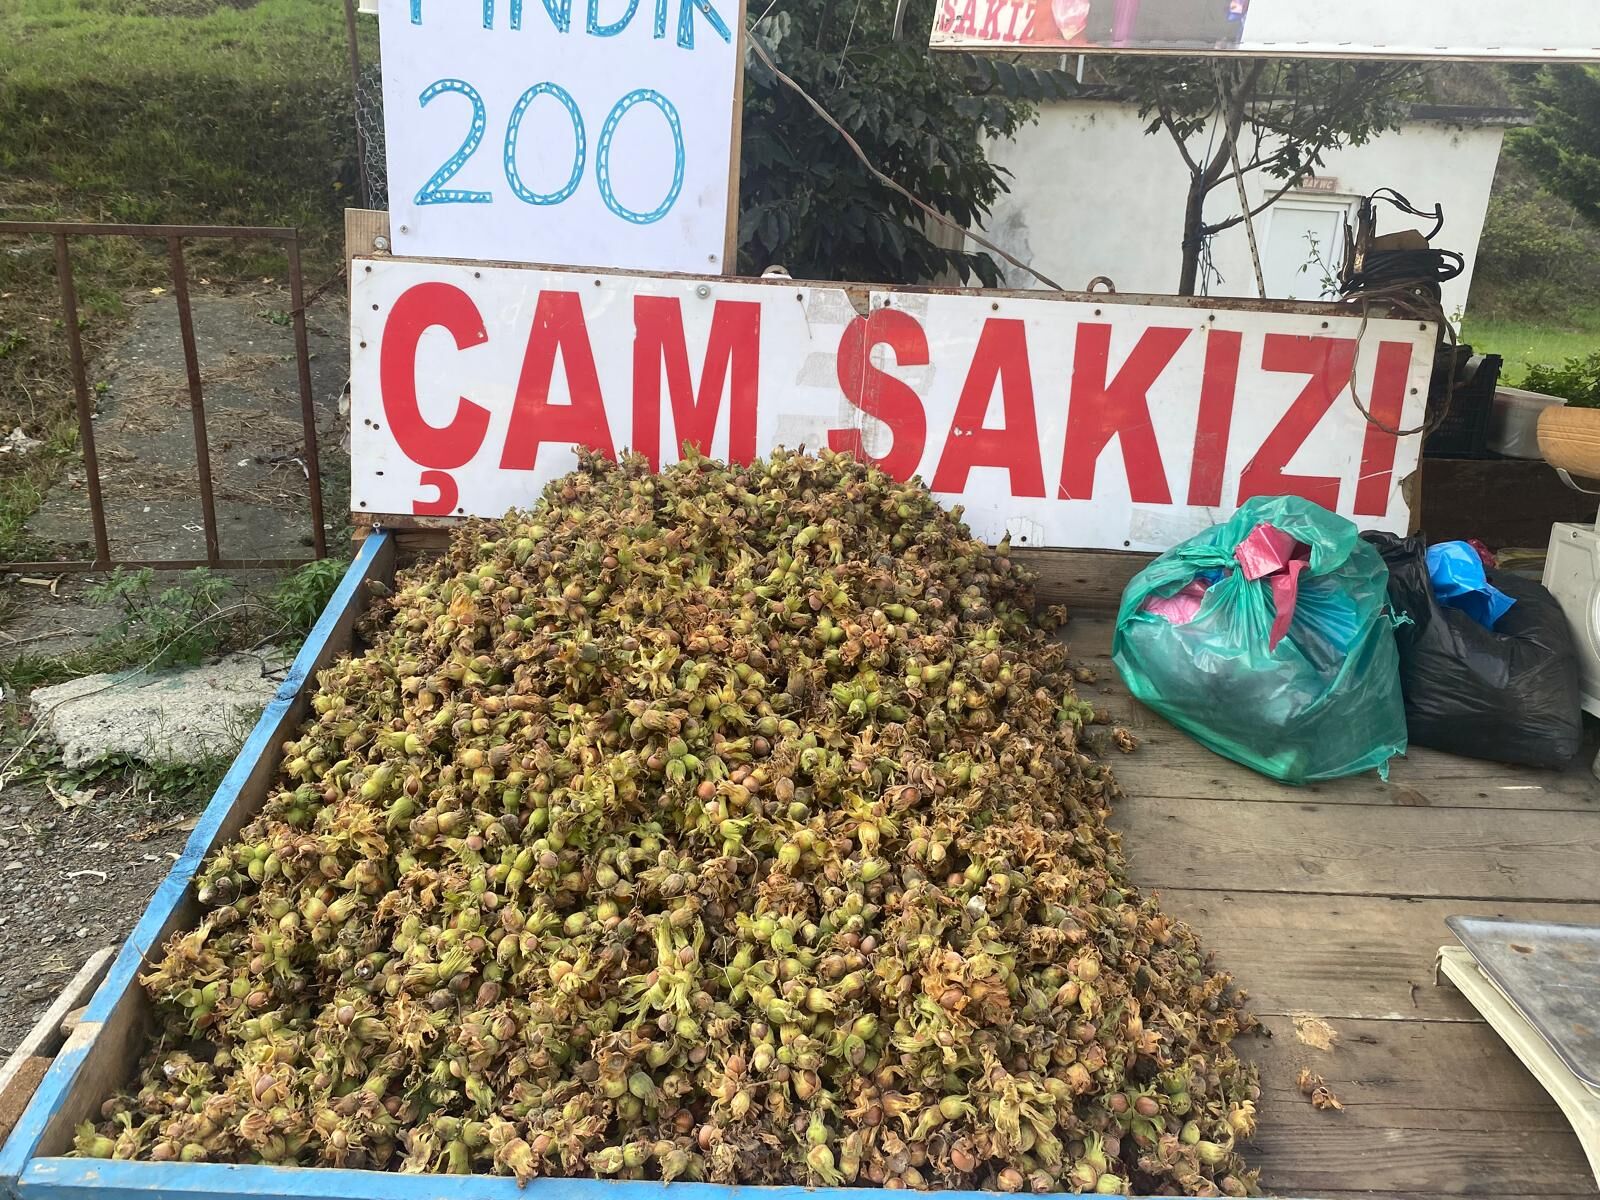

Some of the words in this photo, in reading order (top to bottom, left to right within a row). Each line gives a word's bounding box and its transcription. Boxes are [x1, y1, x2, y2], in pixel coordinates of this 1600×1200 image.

[413, 78, 685, 225] 200
[380, 281, 762, 516] ÇAM
[828, 308, 1413, 518] SAKIZI
